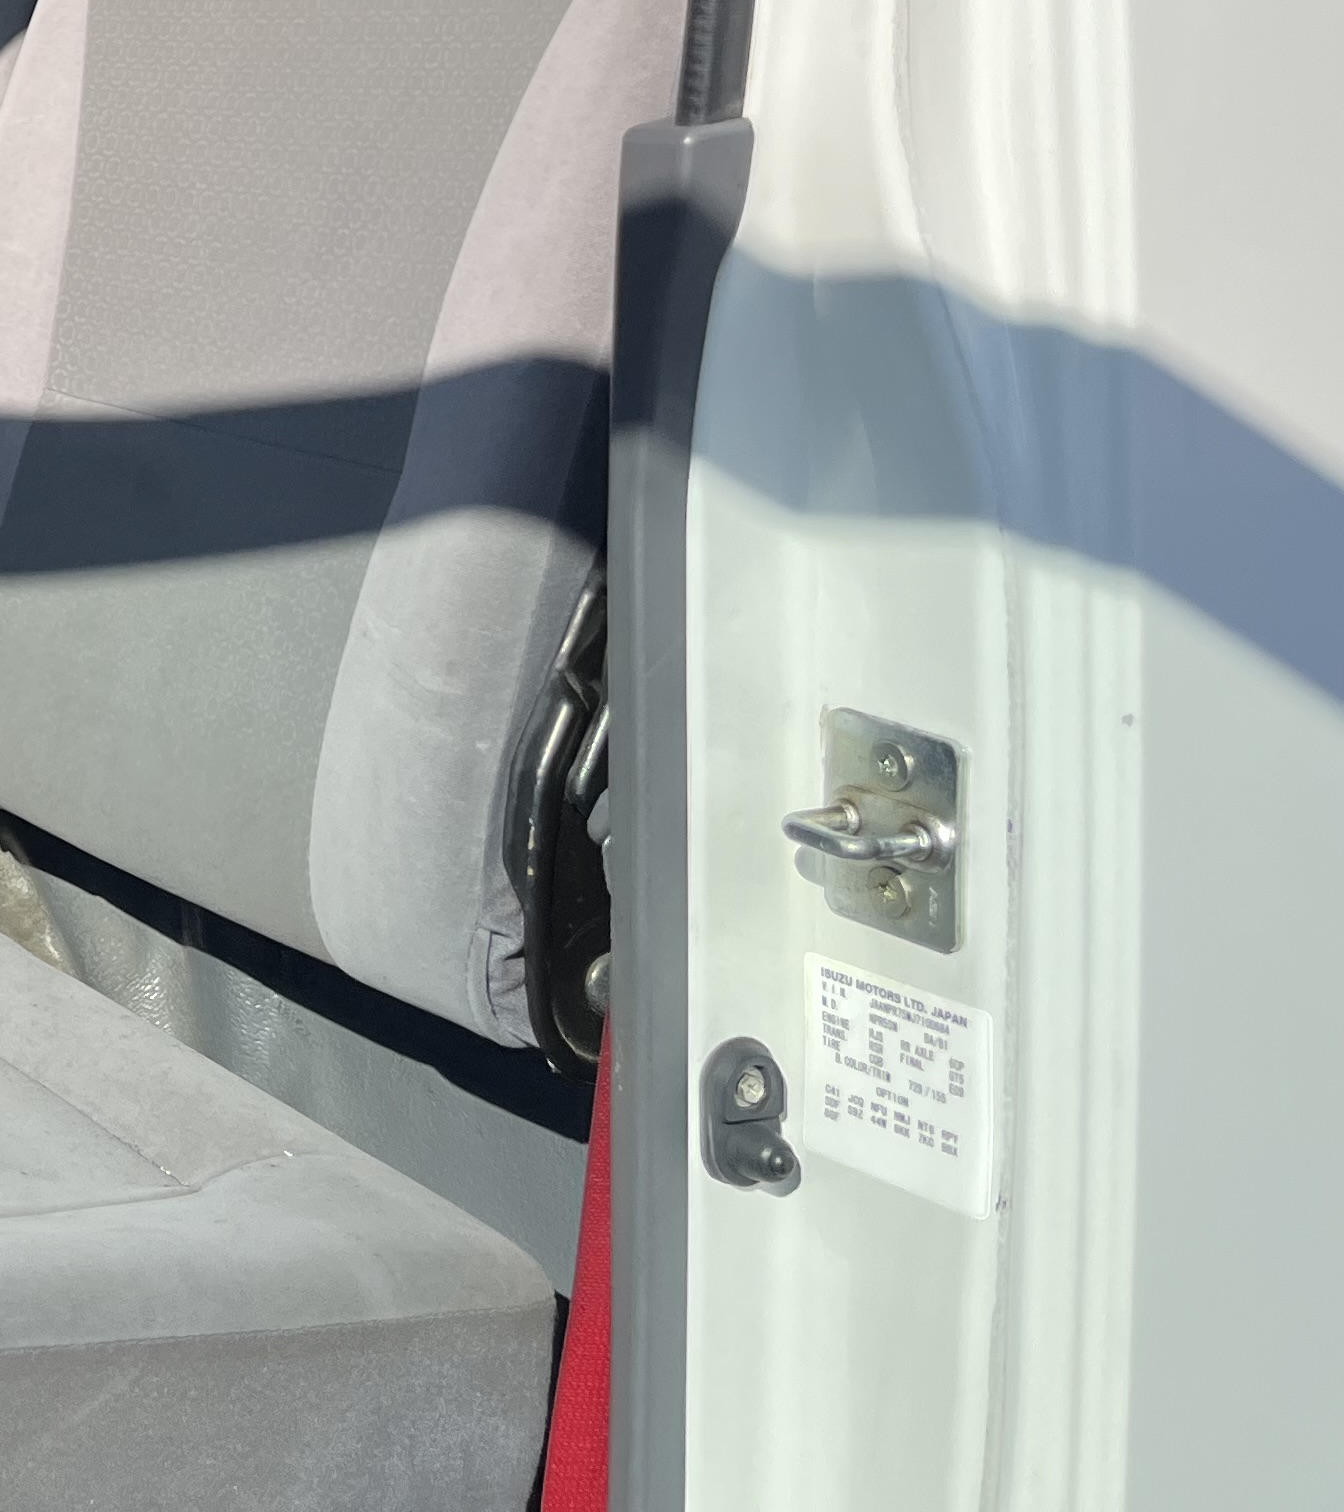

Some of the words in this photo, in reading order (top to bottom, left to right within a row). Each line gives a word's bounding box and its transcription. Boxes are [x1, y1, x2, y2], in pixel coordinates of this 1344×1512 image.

[820, 966, 853, 987] ISUZU
[855, 978, 902, 1004] MOTORS
[903, 996, 928, 1014] LTD.
[931, 1006, 968, 1029] JAPAN
[821, 1010, 850, 1031] ENGINE
[899, 1052, 925, 1072] FINAL
[875, 1086, 910, 1108] OPTION
